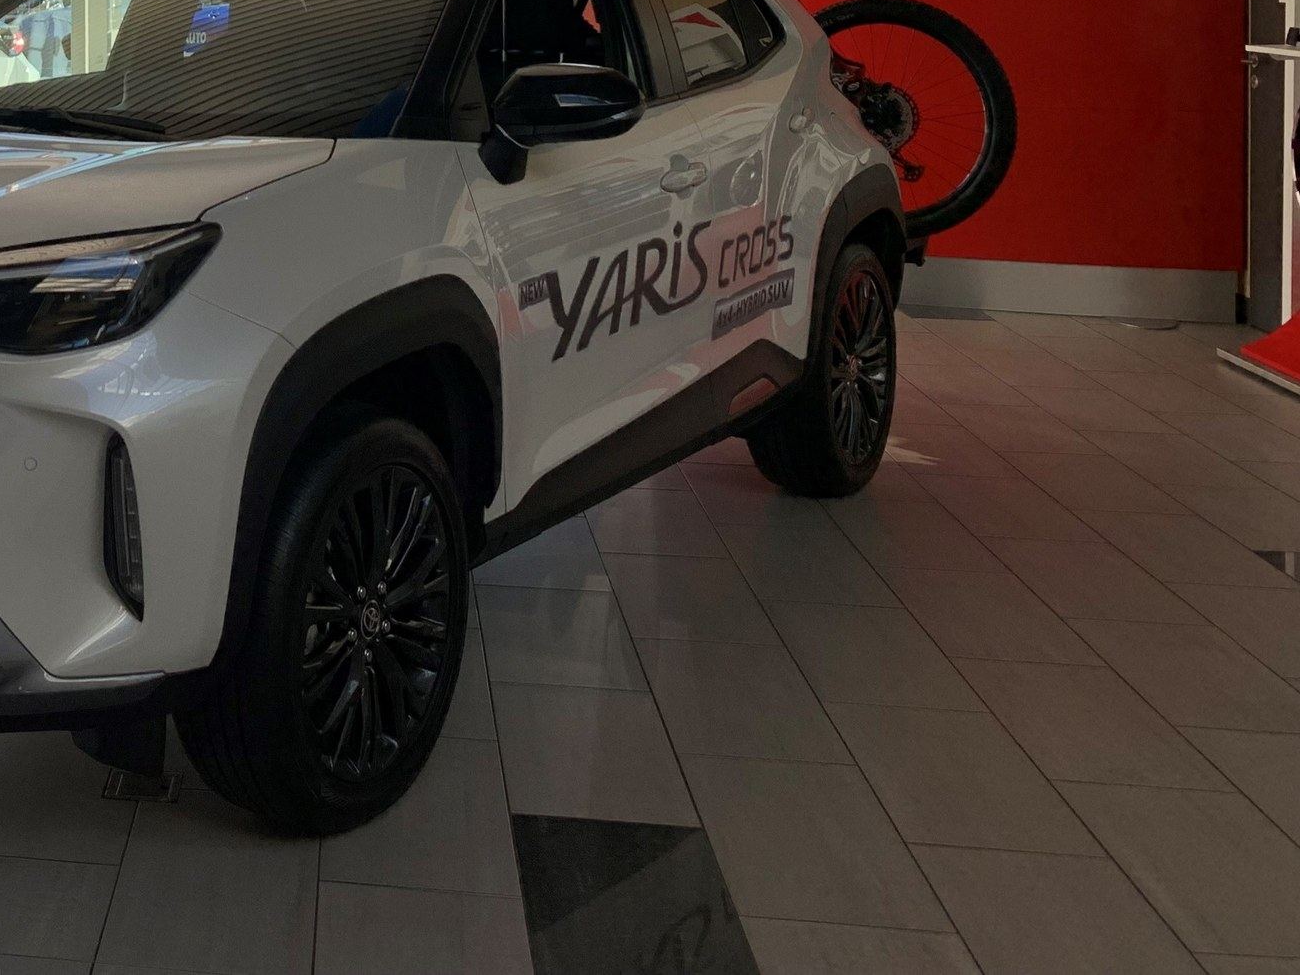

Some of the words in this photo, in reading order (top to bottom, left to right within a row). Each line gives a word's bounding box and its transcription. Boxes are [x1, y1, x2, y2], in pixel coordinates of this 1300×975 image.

[520, 282, 546, 304] NEW
[718, 215, 794, 288] CROSS
[767, 279, 790, 304] SUV
